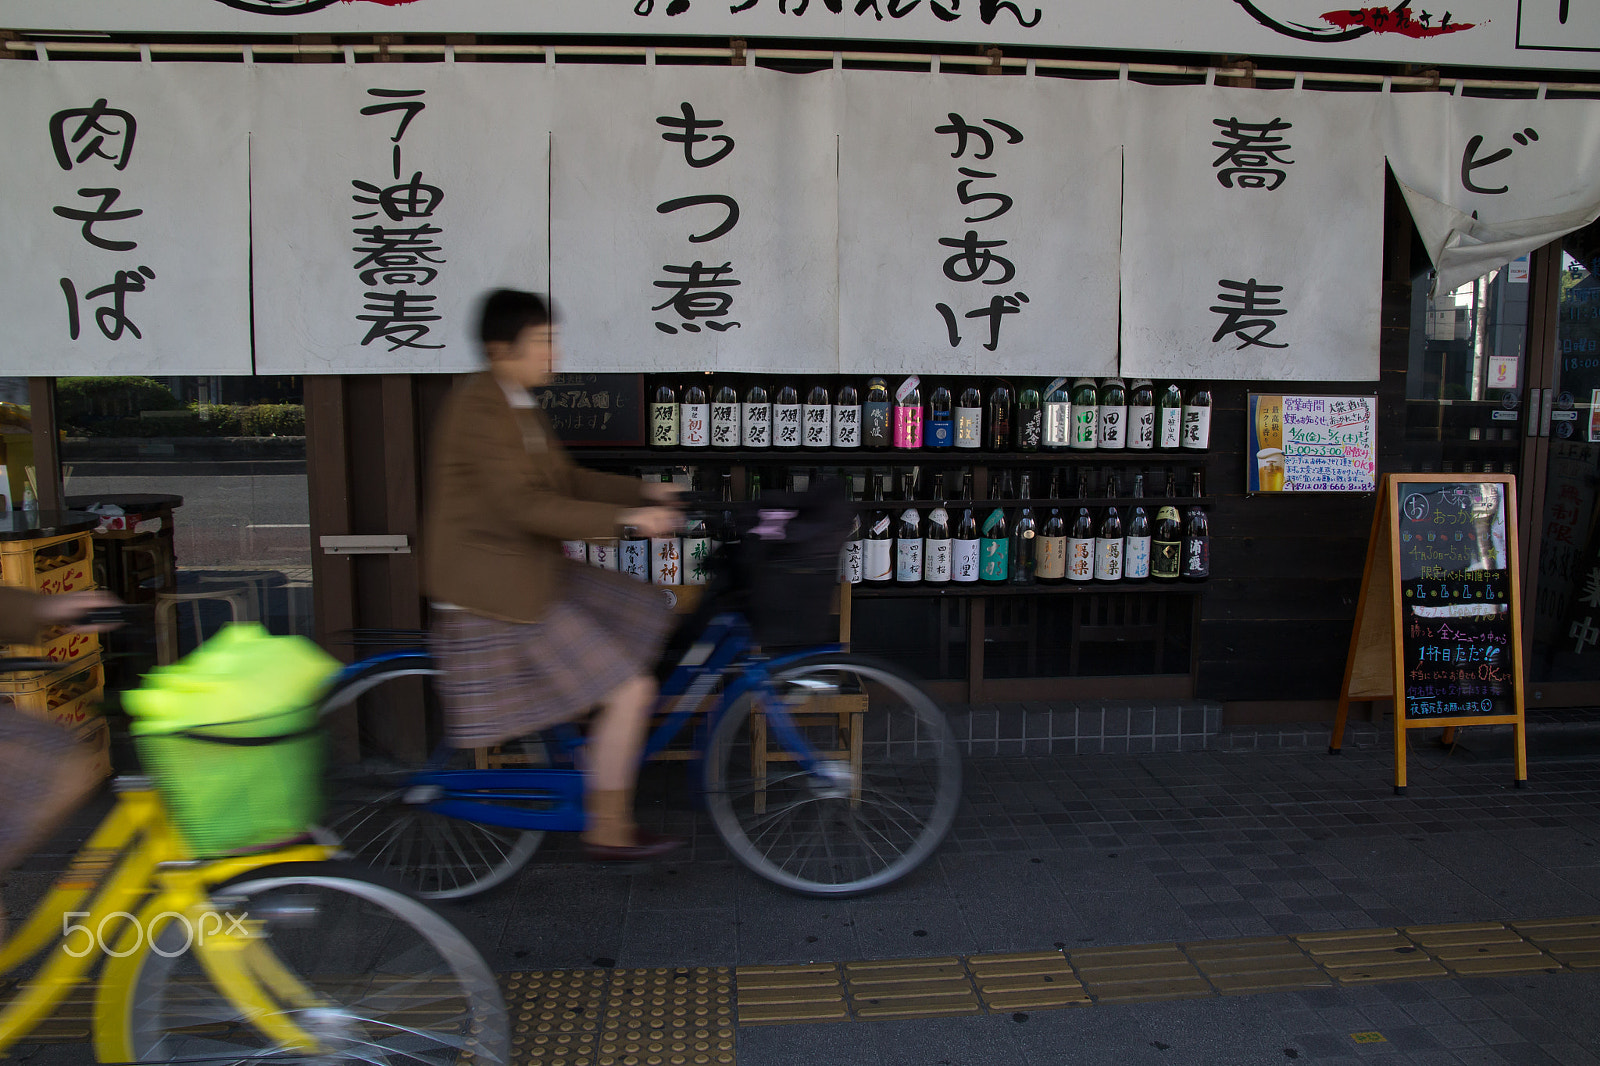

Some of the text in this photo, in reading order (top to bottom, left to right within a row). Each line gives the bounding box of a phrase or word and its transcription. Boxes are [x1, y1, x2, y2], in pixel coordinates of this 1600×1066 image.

[50, 99, 155, 340] 肉そば
[352, 89, 446, 352] ラー油蕎麦
[652, 102, 741, 334] もつ煮
[935, 113, 1029, 351] からあげ
[1210, 117, 1295, 350] 蕎麦
[1462, 128, 1538, 216] ビ
[1284, 398, 1325, 412] 営業時間
